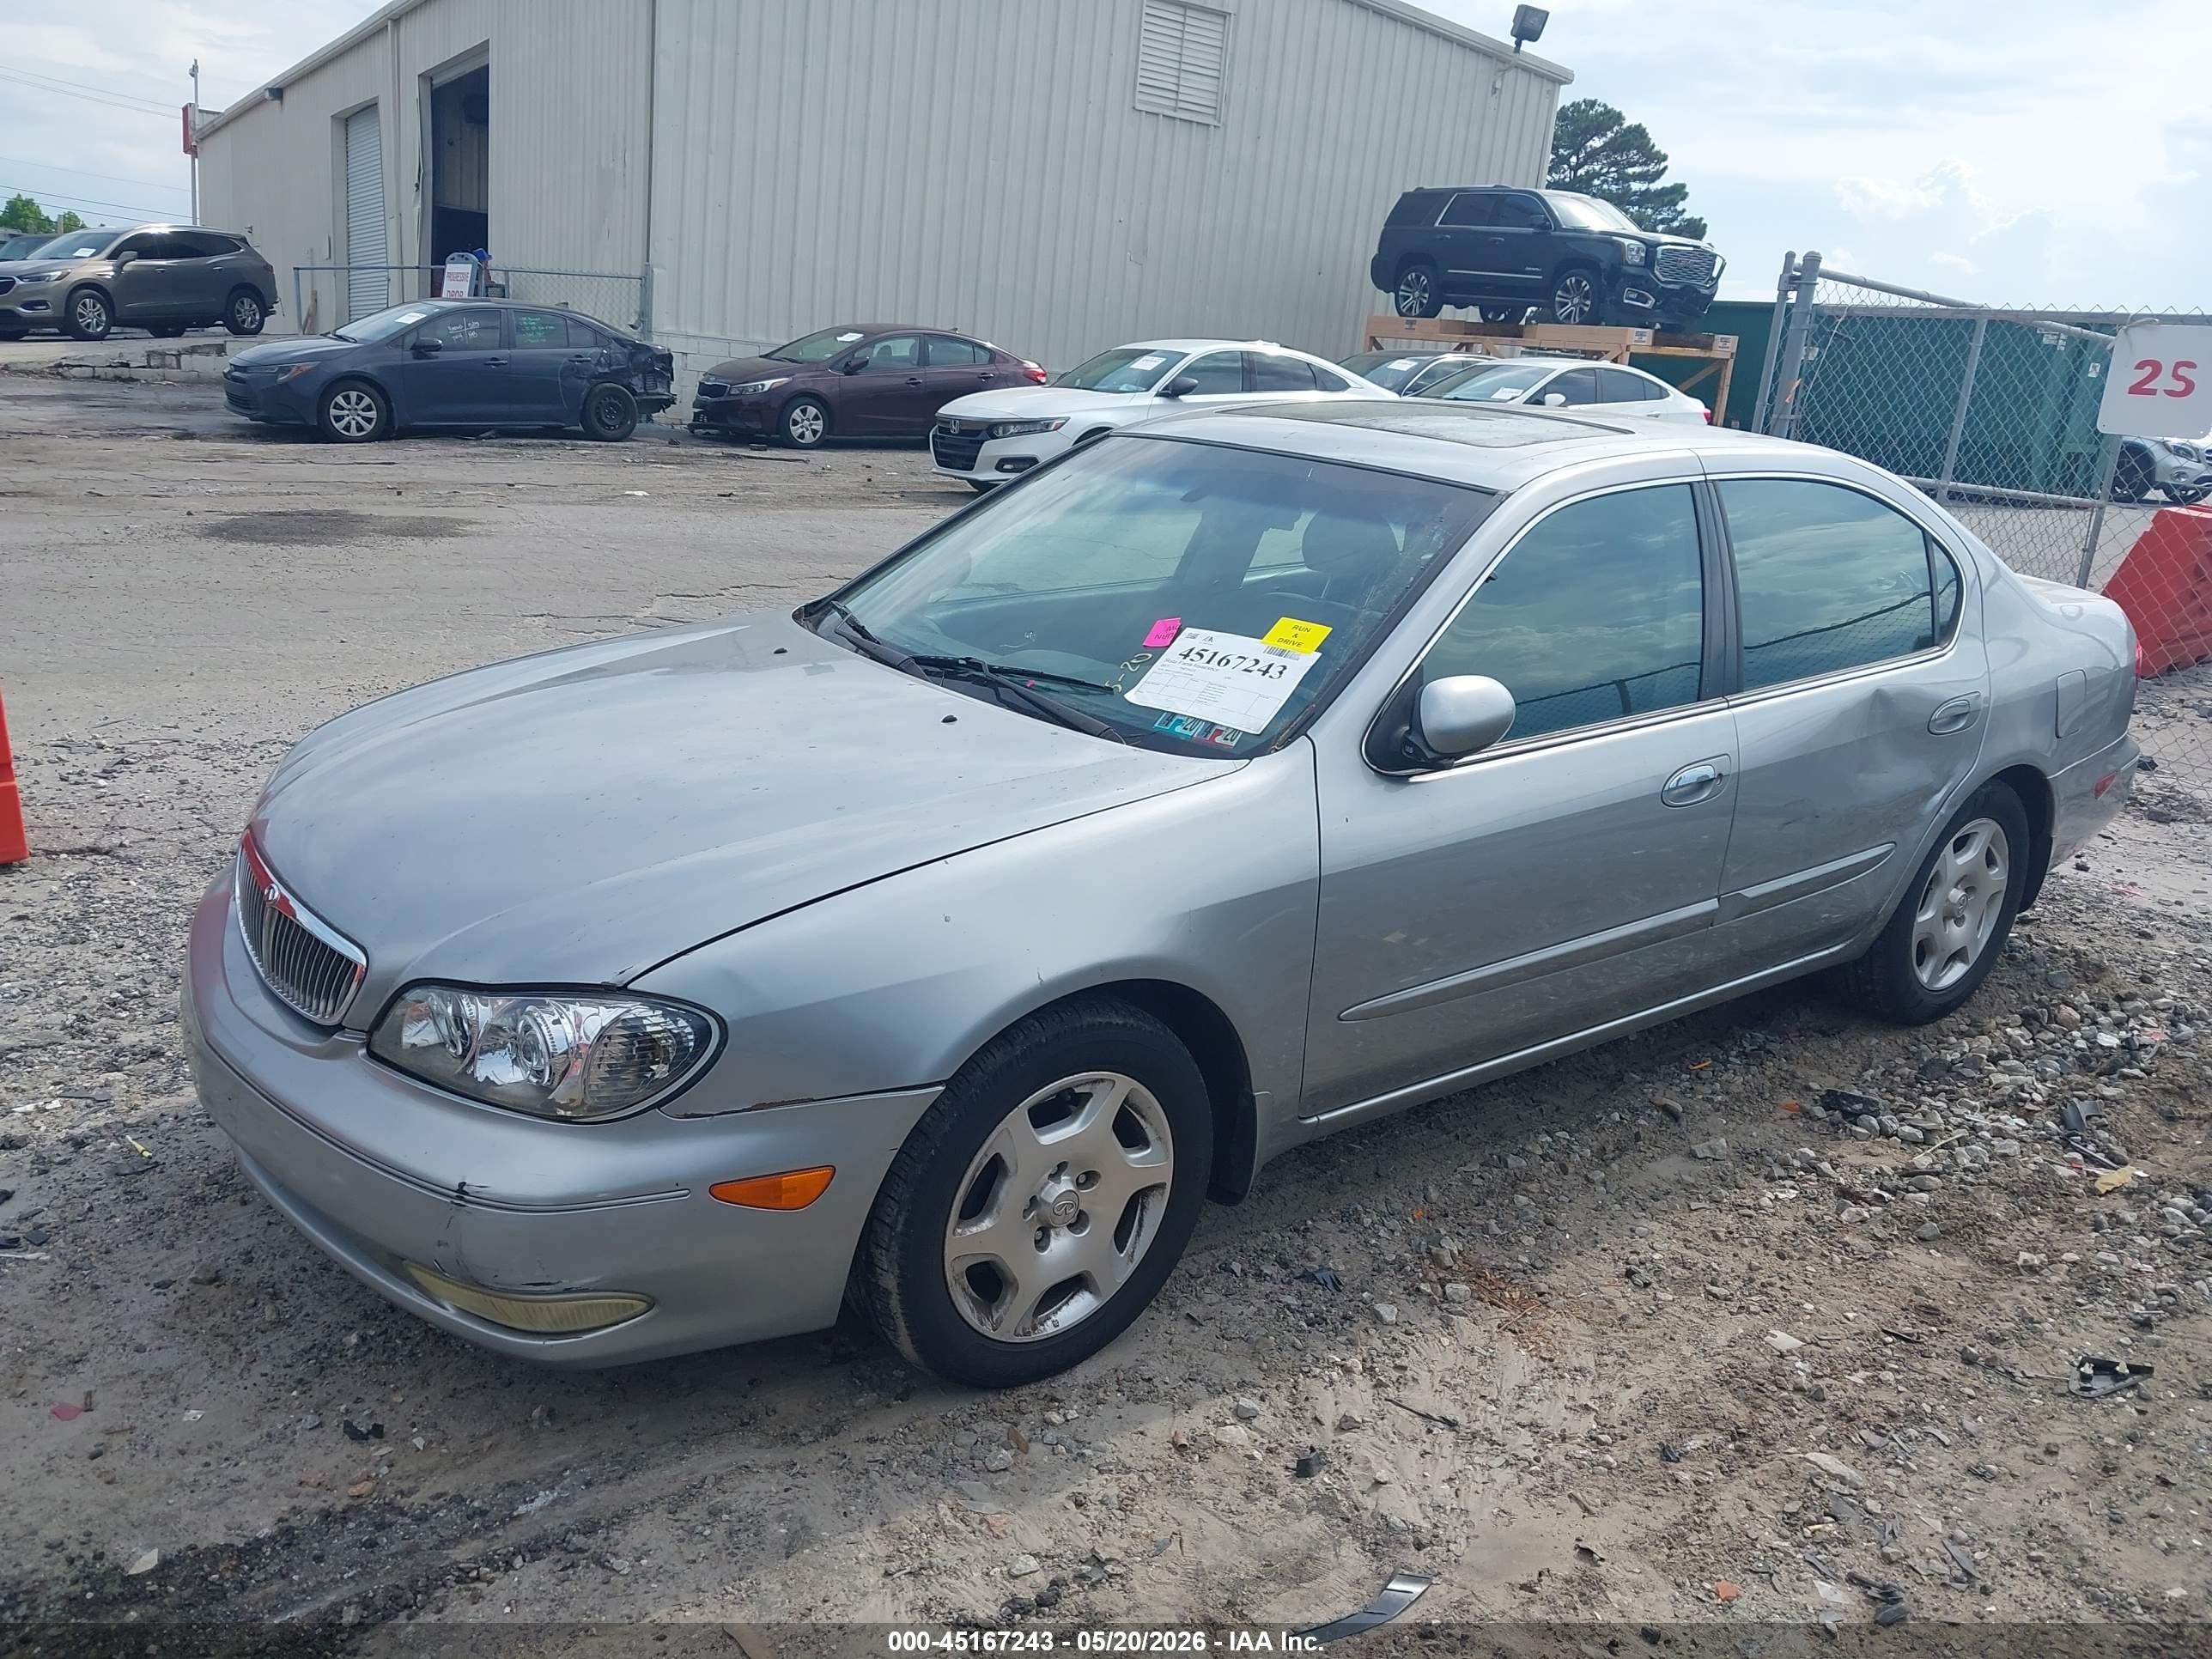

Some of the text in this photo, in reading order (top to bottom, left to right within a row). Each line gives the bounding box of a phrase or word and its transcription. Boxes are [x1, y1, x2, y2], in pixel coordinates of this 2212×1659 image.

[1291, 624, 1313, 634] RUN
[1276, 636, 1305, 648] DRIVE
[1177, 646, 1289, 681] 45167243
[1182, 716, 1200, 732] 20
[1223, 727, 1240, 743] 20
